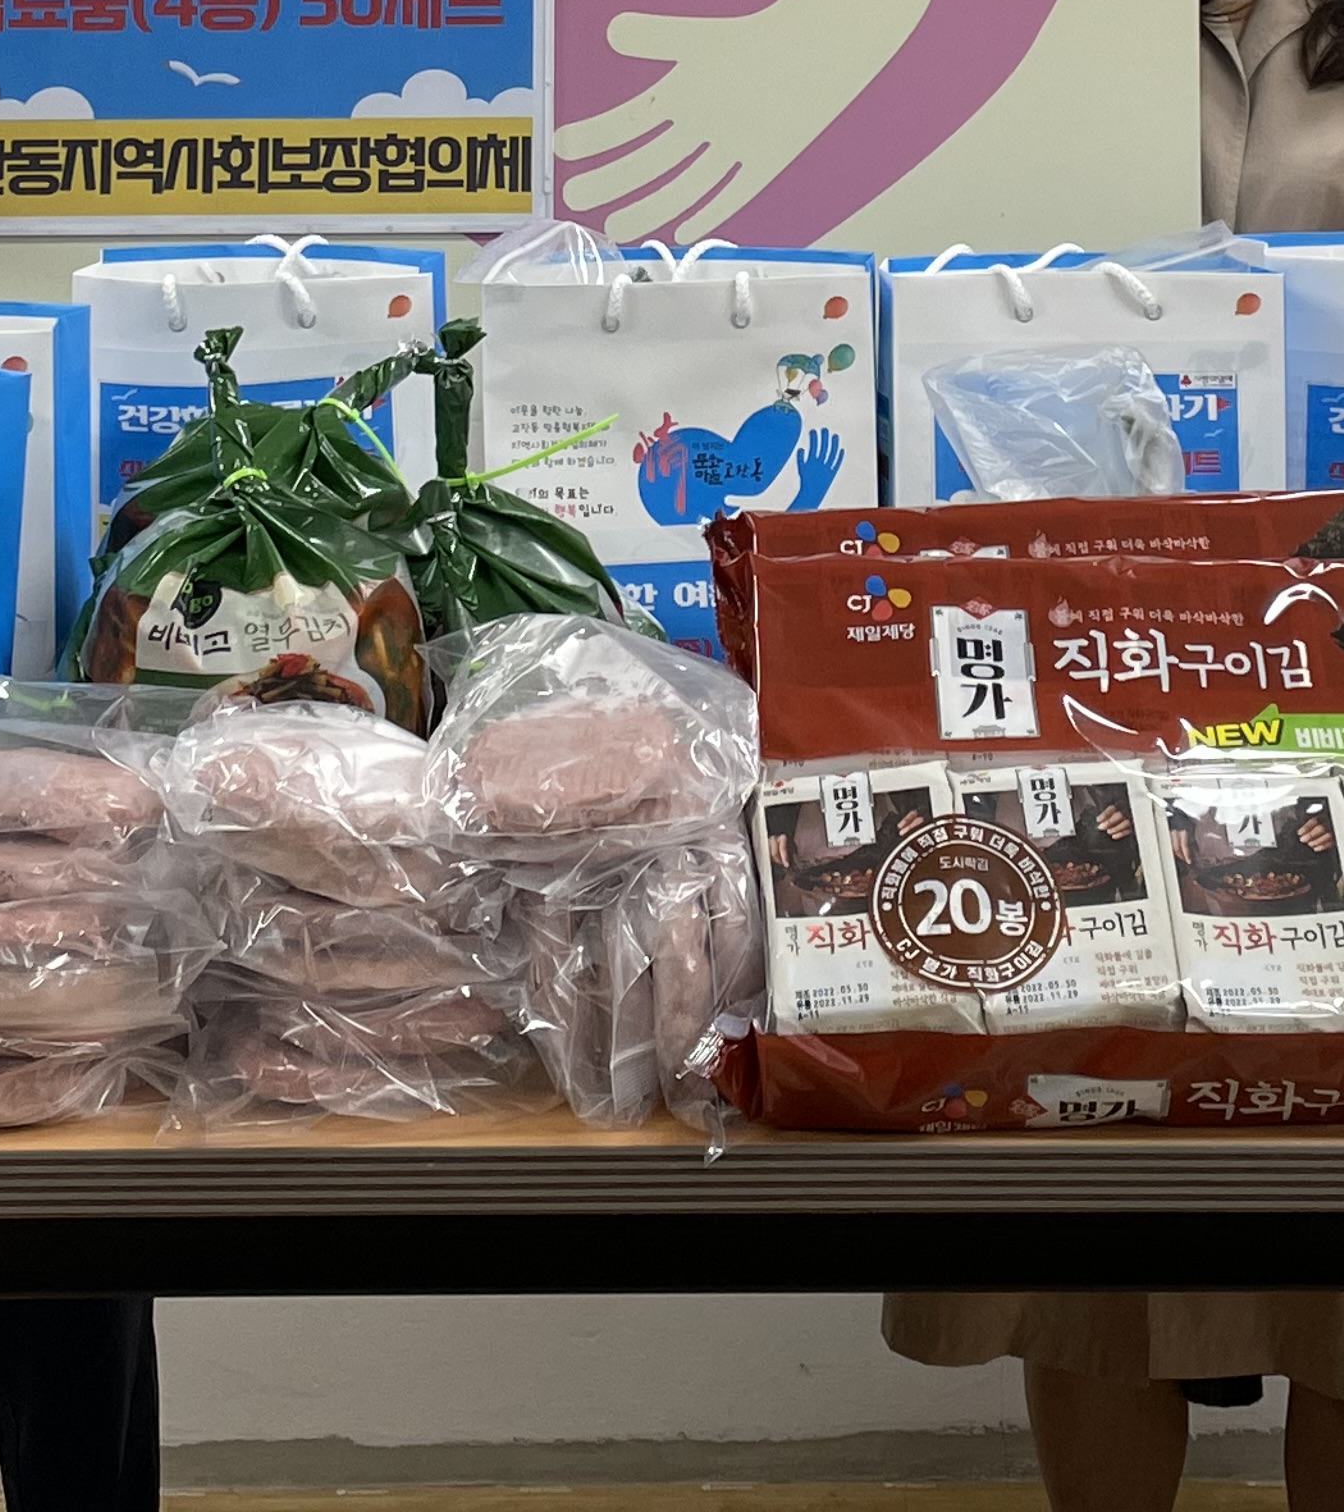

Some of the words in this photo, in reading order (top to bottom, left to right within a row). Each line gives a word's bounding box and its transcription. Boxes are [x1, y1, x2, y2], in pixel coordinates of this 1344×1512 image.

[839, 539, 864, 556] CJ
[1064, 540, 1090, 556] 직접
[1093, 537, 1118, 552] 구워
[1120, 536, 1146, 551] 더욱
[846, 594, 873, 613] CJ
[1087, 607, 1114, 623] 직접
[1119, 606, 1146, 622] 구워
[1148, 608, 1176, 623] 더욱
[1178, 609, 1245, 628] 바삭바삭한
[147, 621, 232, 656] 비비고
[243, 613, 353, 653] 열무김치
[846, 623, 916, 643] 제일제당
[1052, 628, 1314, 694] 직화구이김
[956, 637, 1013, 721] 명가
[1187, 719, 1282, 749] NEW
[832, 785, 864, 834] 명가
[1029, 777, 1062, 826] 명가
[917, 827, 950, 849] 직접
[953, 823, 985, 843] 구워
[988, 833, 1020, 859] 더욱
[1017, 855, 1051, 900] 바삭한
[938, 855, 990, 872] 도시락김
[784, 924, 802, 957] 명가
[1192, 921, 1208, 953] 명가
[896, 938, 921, 961] CJ
[922, 956, 958, 980] 명가
[965, 939, 1045, 983] 직화구이김
[920, 1097, 947, 1113] CJ
[1059, 1099, 1143, 1123] 명가
